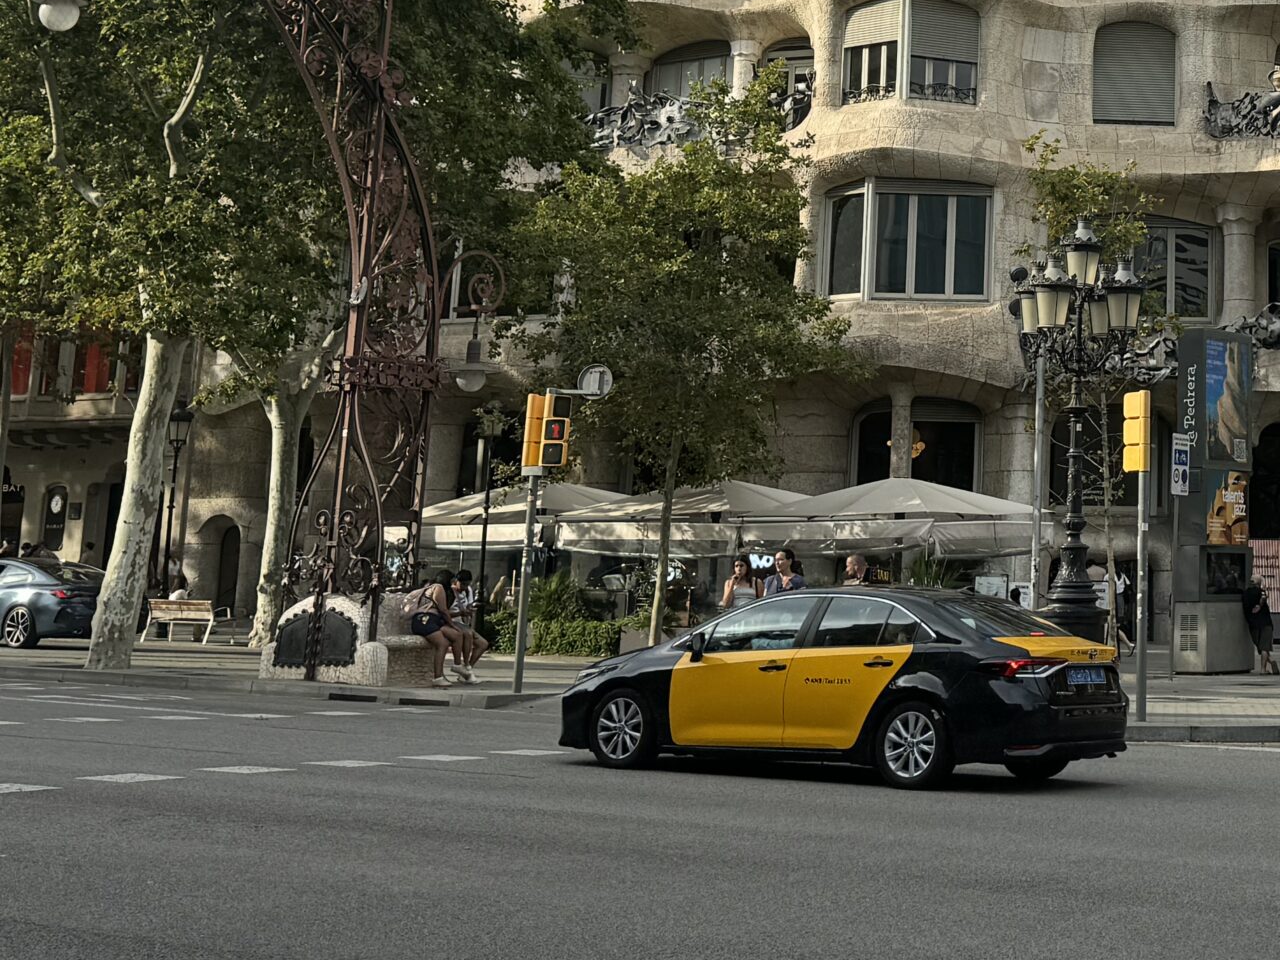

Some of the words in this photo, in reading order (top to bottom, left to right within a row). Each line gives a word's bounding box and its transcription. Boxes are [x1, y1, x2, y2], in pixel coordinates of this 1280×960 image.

[1184, 364, 1197, 429] Pedrera
[1187, 430, 1198, 447] La
[3, 484, 21, 492] BAT
[1222, 488, 1244, 504] talents
[1232, 504, 1246, 518] jazz
